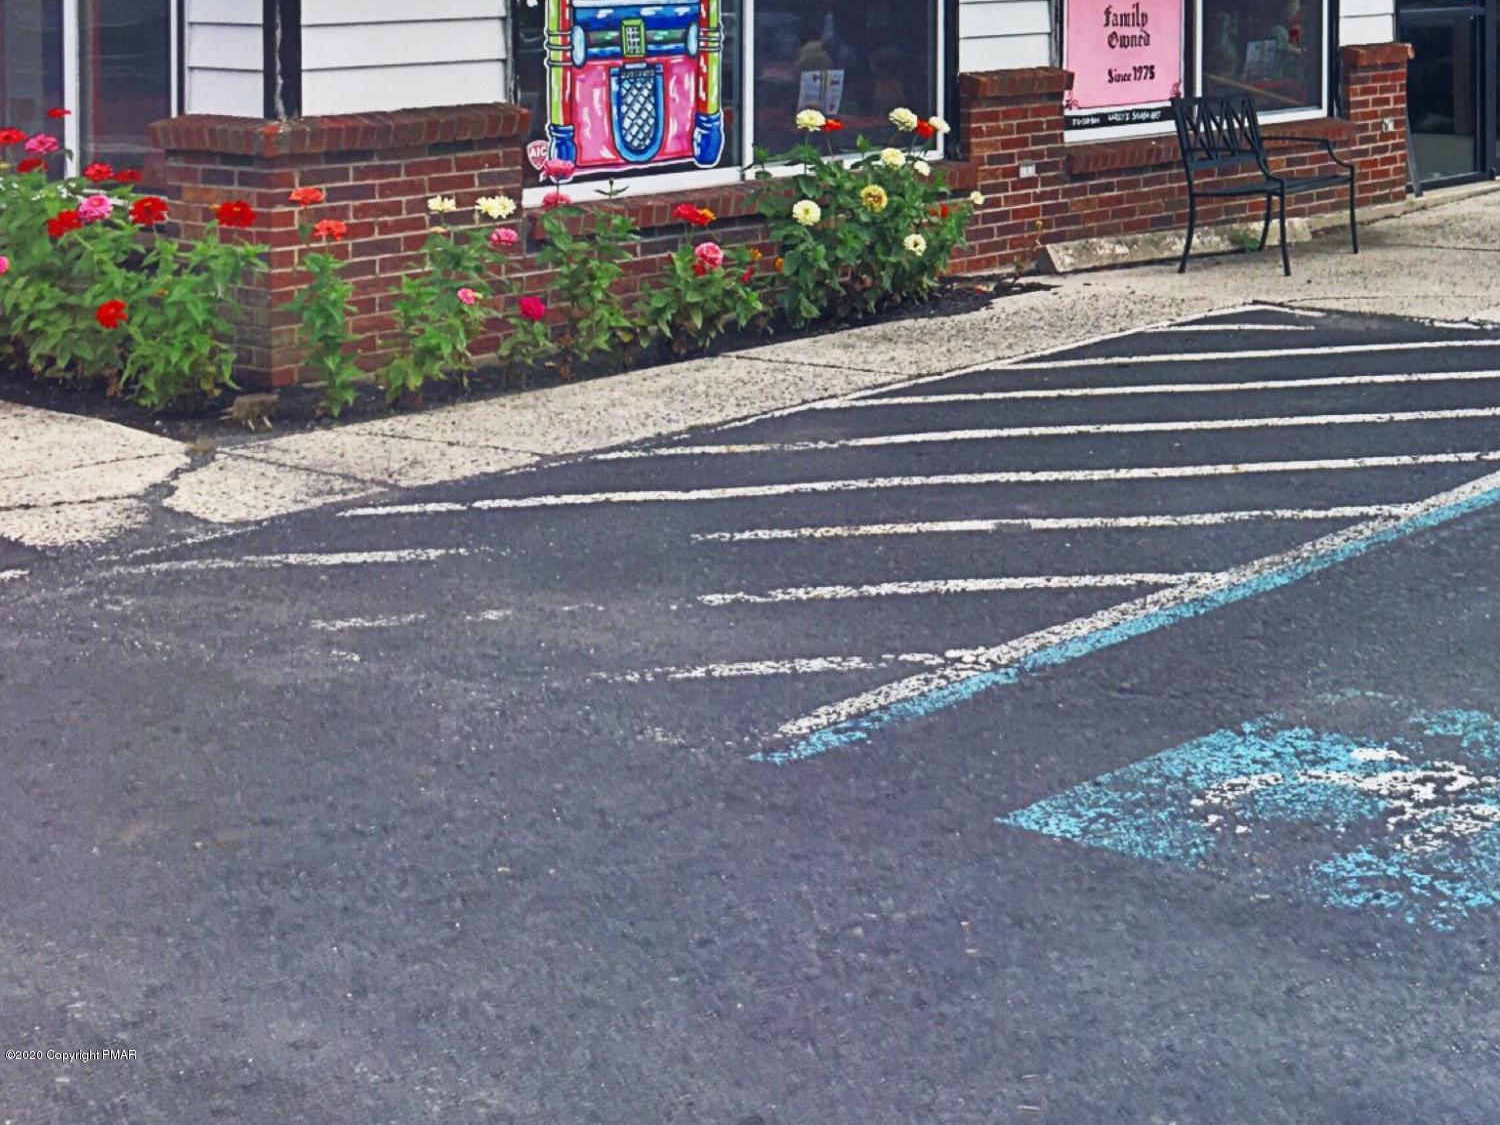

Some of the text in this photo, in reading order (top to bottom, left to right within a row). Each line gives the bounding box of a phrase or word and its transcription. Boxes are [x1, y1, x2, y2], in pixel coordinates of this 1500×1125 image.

[1107, 29, 1151, 49] Owned
[1107, 64, 1155, 83] Since 1975
